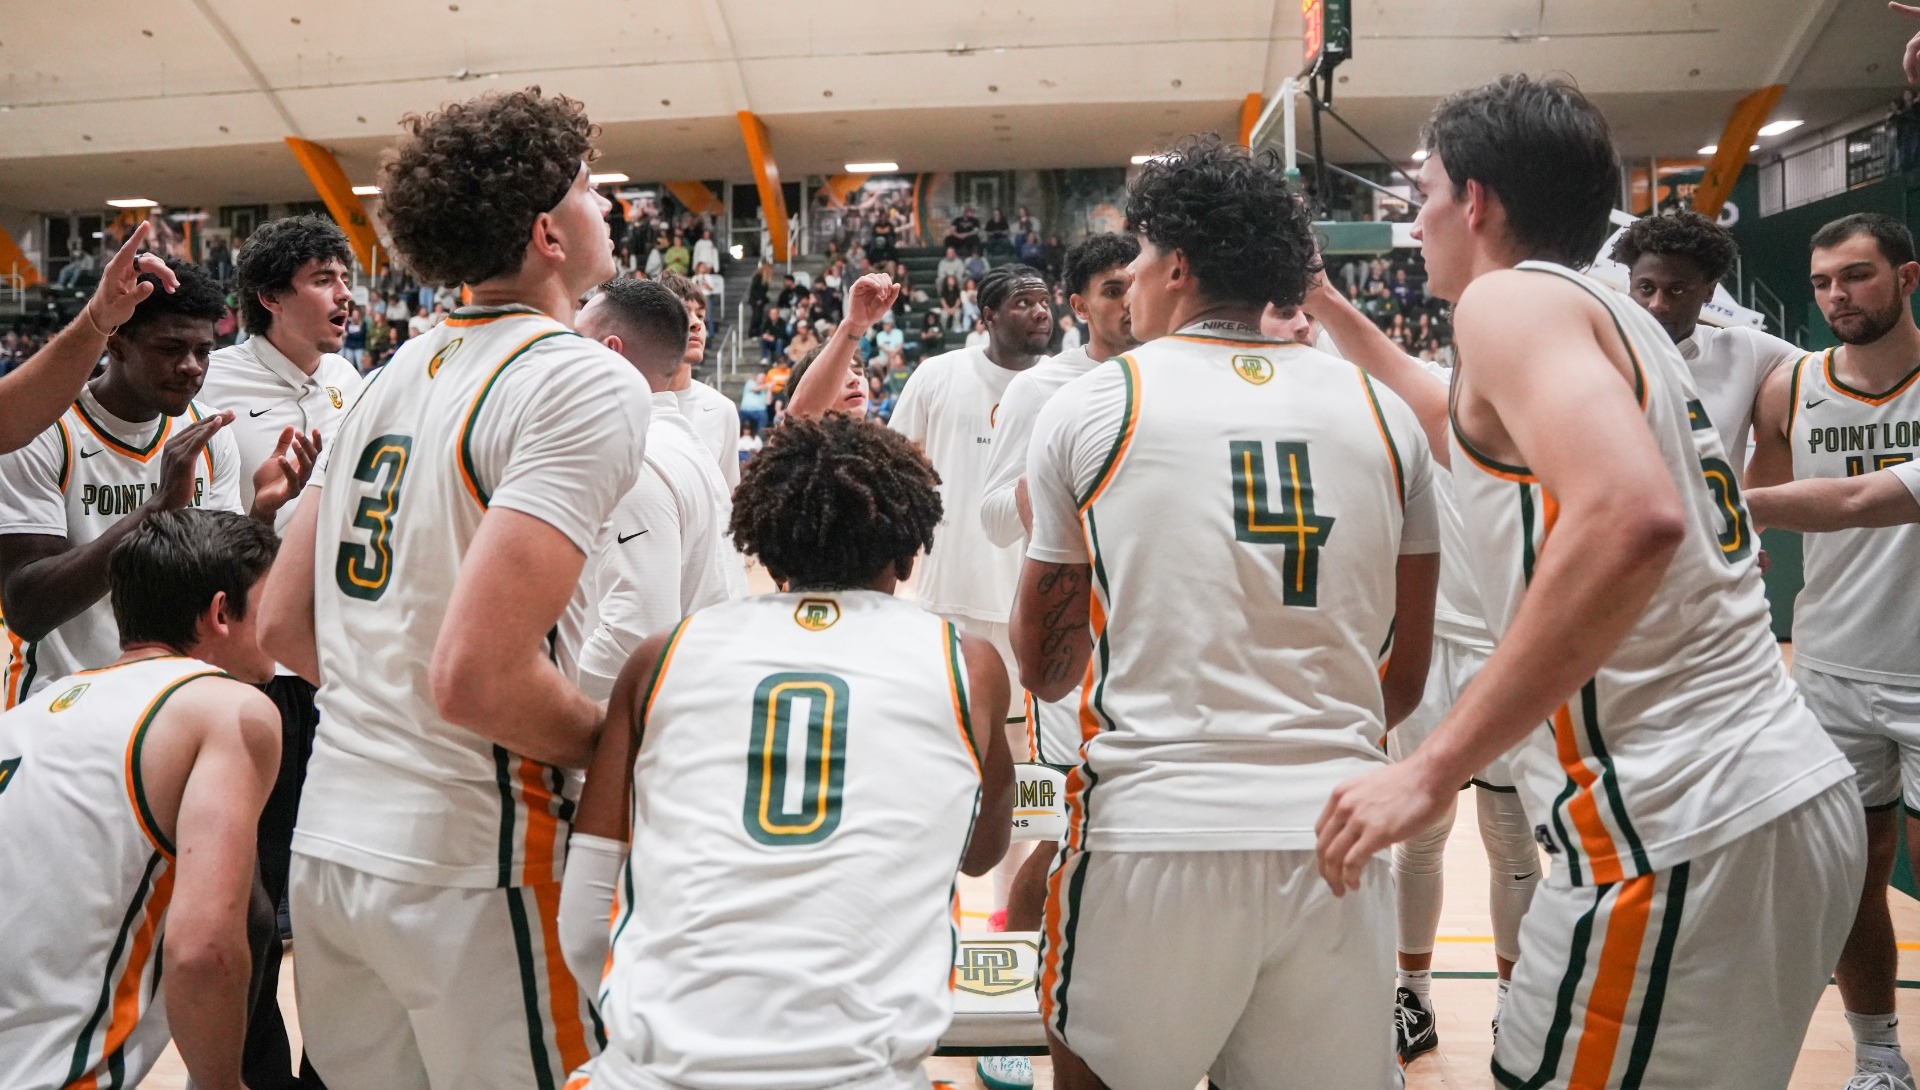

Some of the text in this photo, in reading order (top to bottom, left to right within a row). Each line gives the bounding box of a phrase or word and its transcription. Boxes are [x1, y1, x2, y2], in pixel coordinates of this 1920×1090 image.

[1202, 321, 1235, 331] NIKE
[1808, 424, 1877, 454] POINT
[81, 483, 146, 515] POINT
[335, 433, 413, 602] 3
[1230, 440, 1336, 607] 4
[1013, 779, 1057, 808] MA
